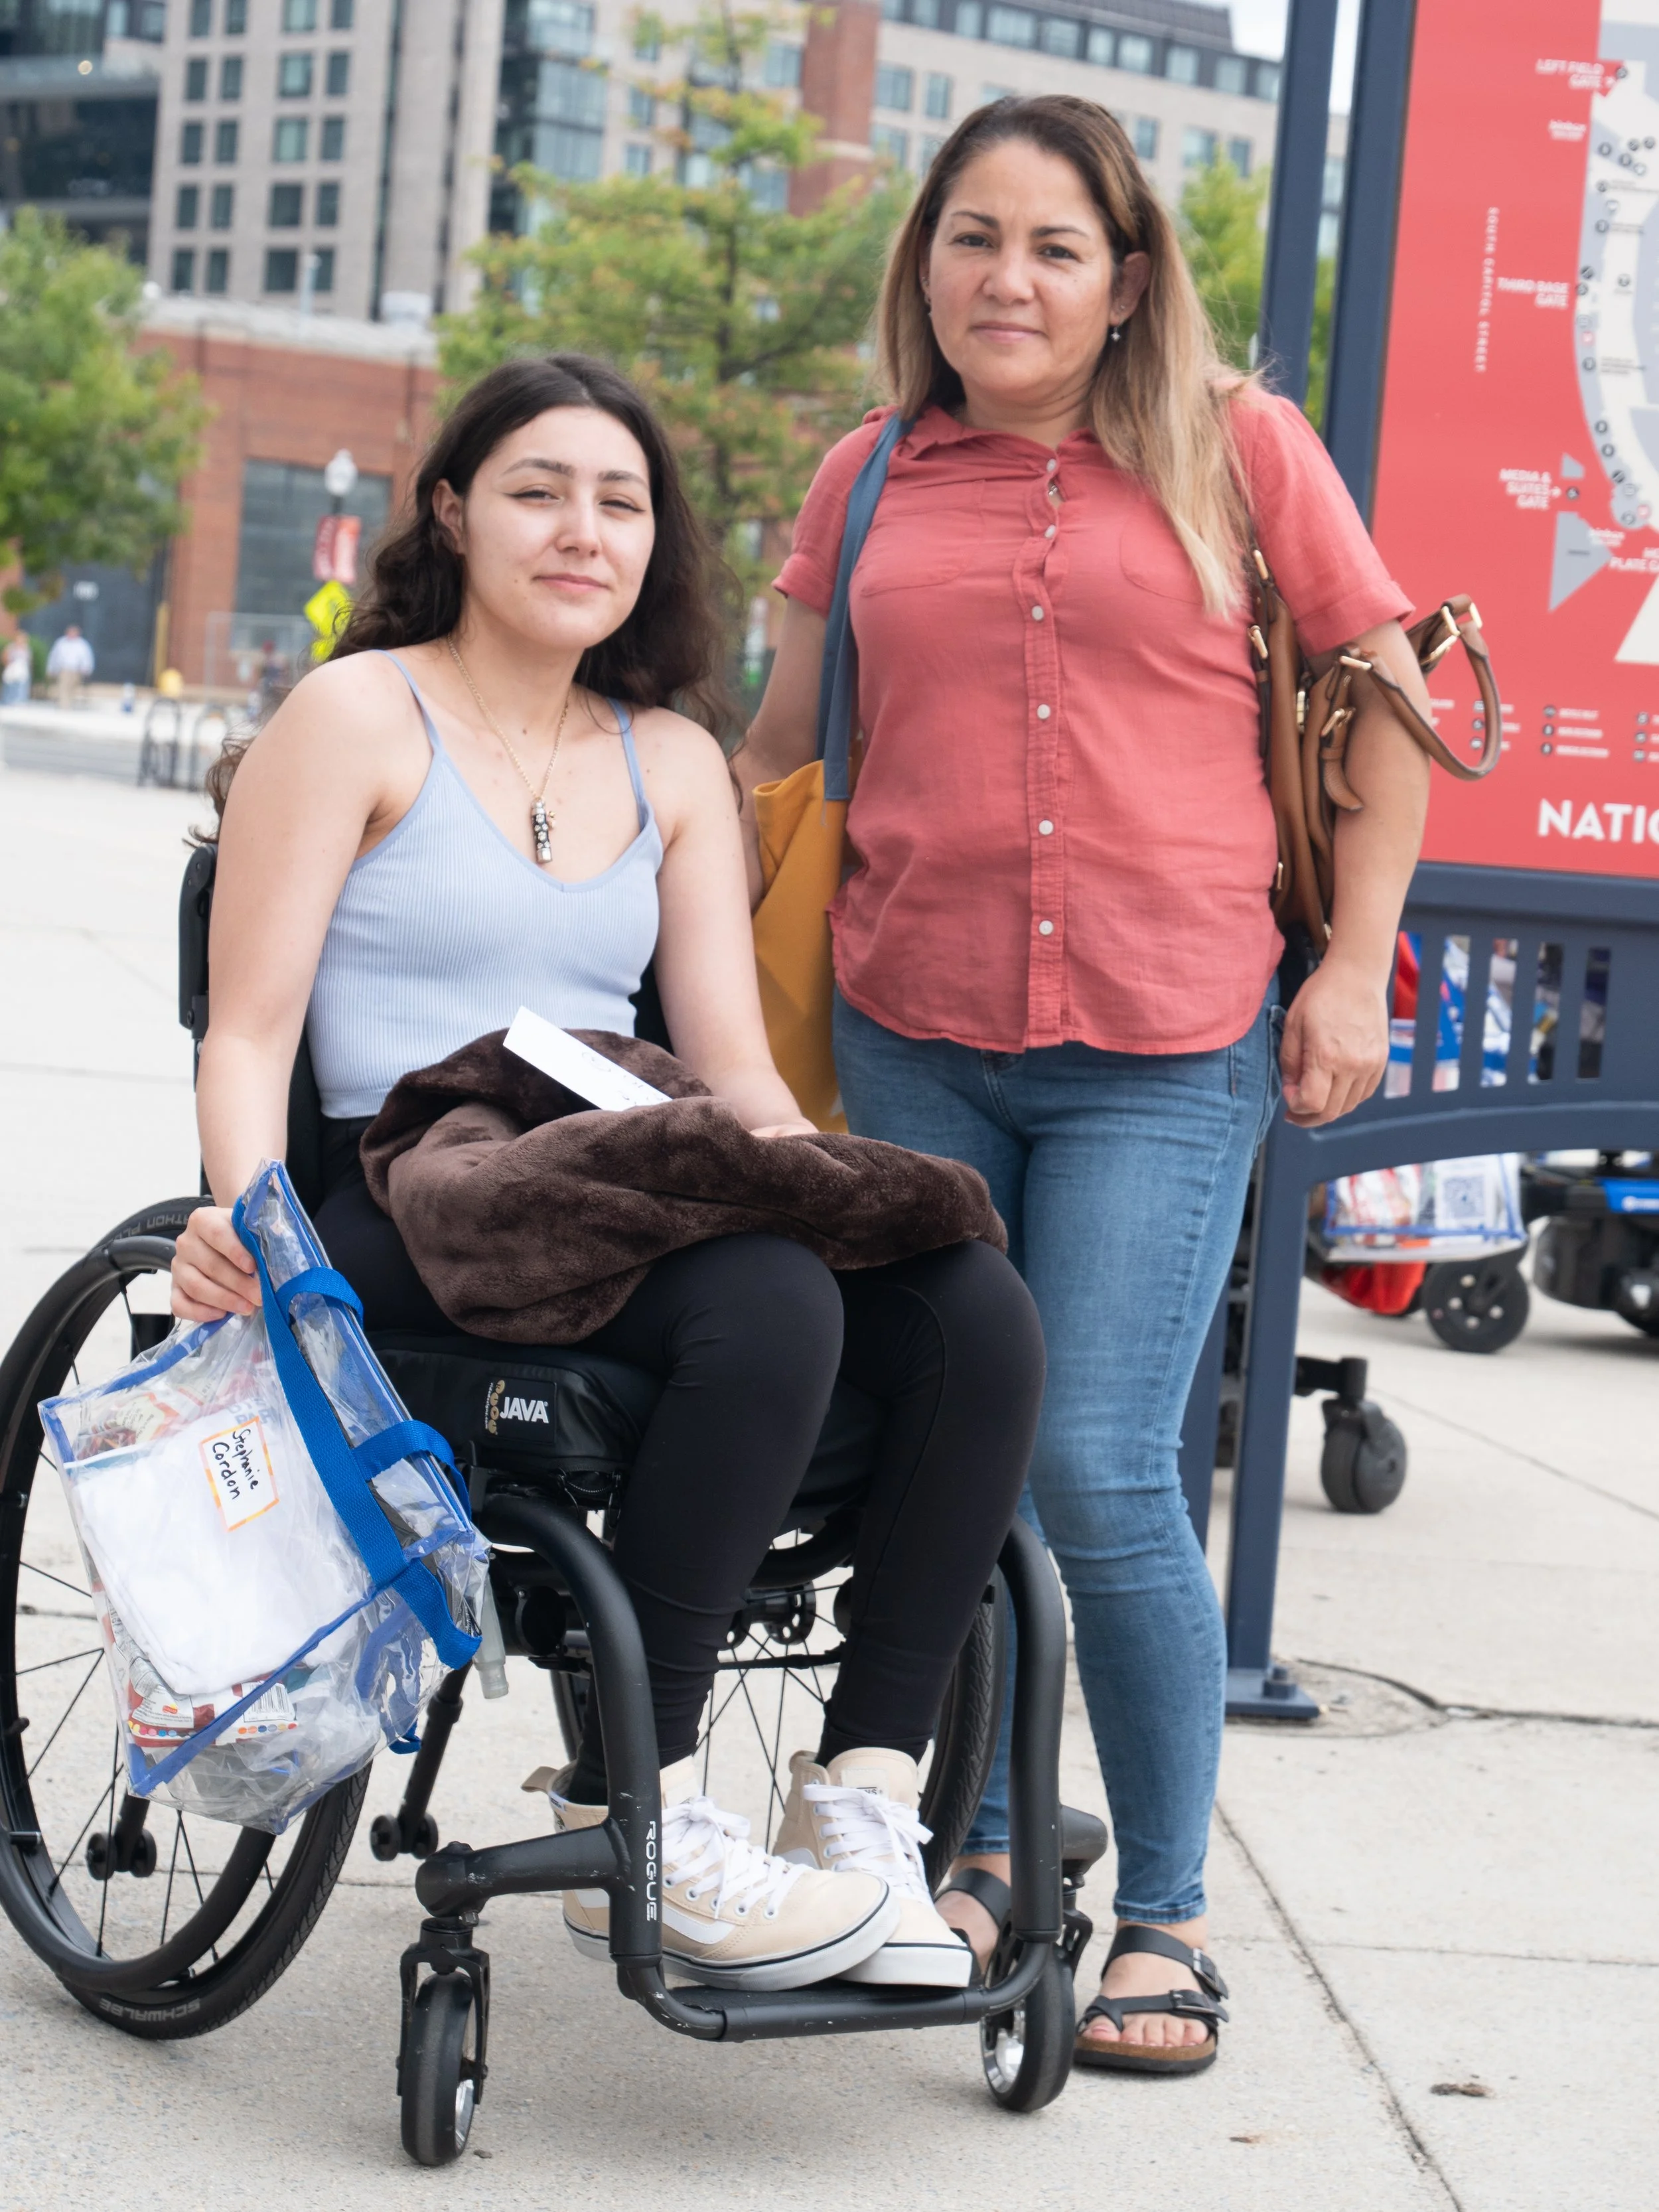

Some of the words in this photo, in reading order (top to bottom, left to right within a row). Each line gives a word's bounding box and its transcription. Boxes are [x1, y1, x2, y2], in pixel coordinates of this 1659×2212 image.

[1537, 59, 1567, 74] LEFT
[1568, 62, 1605, 76] FIELD
[1569, 74, 1602, 90] GATE
[1484, 207, 1500, 254] SOUTH
[1479, 258, 1496, 316] CAPITOL
[1498, 277, 1535, 293] THIRD
[1536, 281, 1569, 294] BASE
[1536, 294, 1568, 309] GATE
[1474, 321, 1490, 373] STREET
[1500, 469, 1540, 482] MEDIA
[1517, 496, 1549, 510] GATE
[1538, 798, 1659, 844] NATI
[500, 1396, 549, 1424] JAVA
[212, 1442, 240, 1499] Cordon
[230, 1429, 259, 1489] Stephanie
[646, 1820, 657, 1921] ROGUE
[99, 1998, 201, 2022] SCHWALBE
